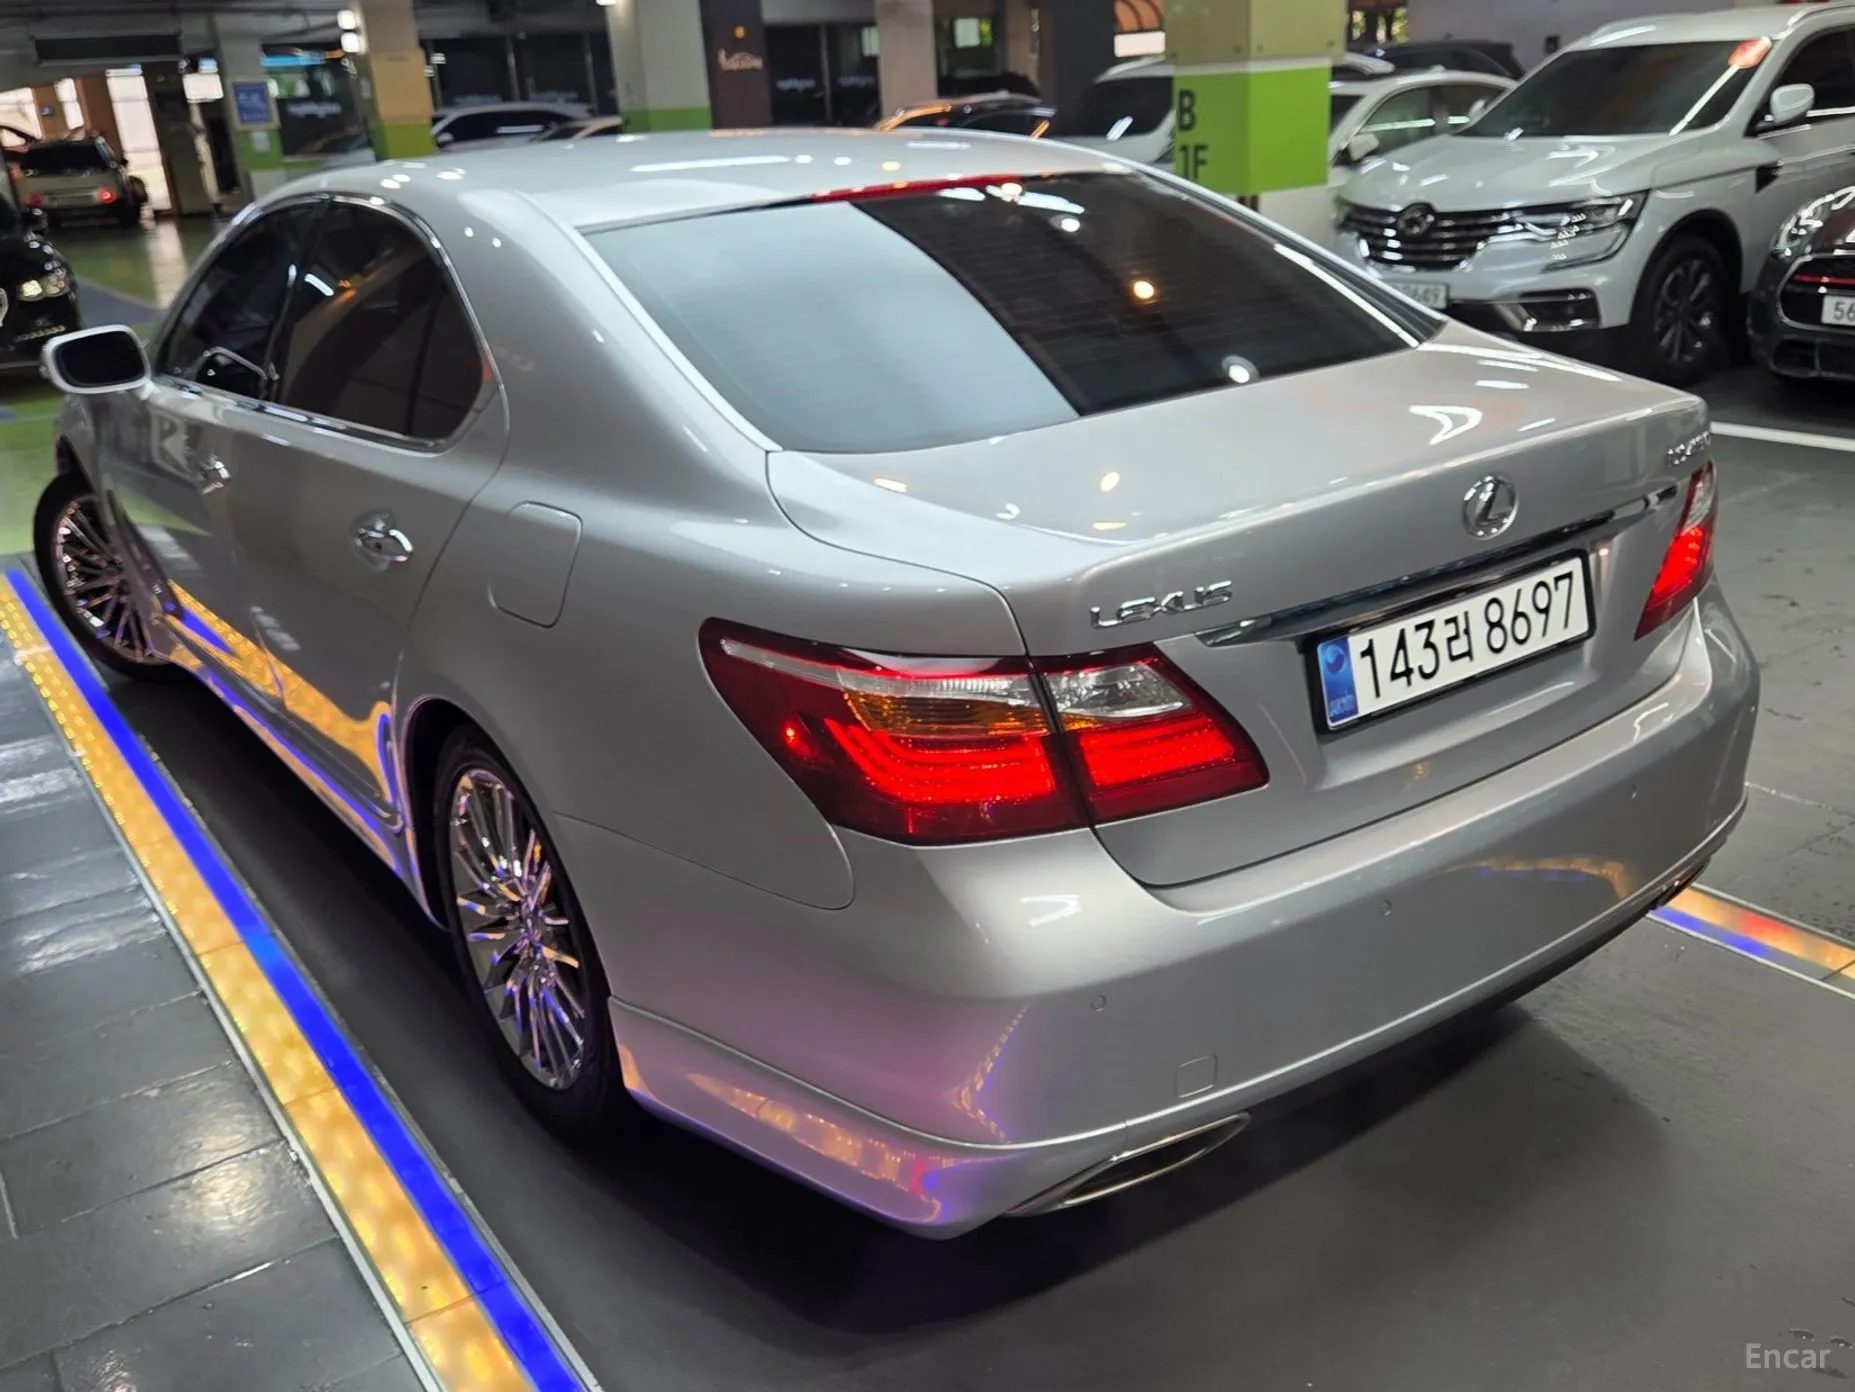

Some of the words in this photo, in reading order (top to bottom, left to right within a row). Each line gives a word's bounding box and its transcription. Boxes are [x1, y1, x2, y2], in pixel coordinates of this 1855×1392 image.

[1178, 89, 1197, 131] B
[1179, 144, 1208, 180] 1F
[1089, 580, 1233, 629] LEXUS
[1360, 611, 1474, 698] 143러
[1484, 571, 1574, 654] 8697
